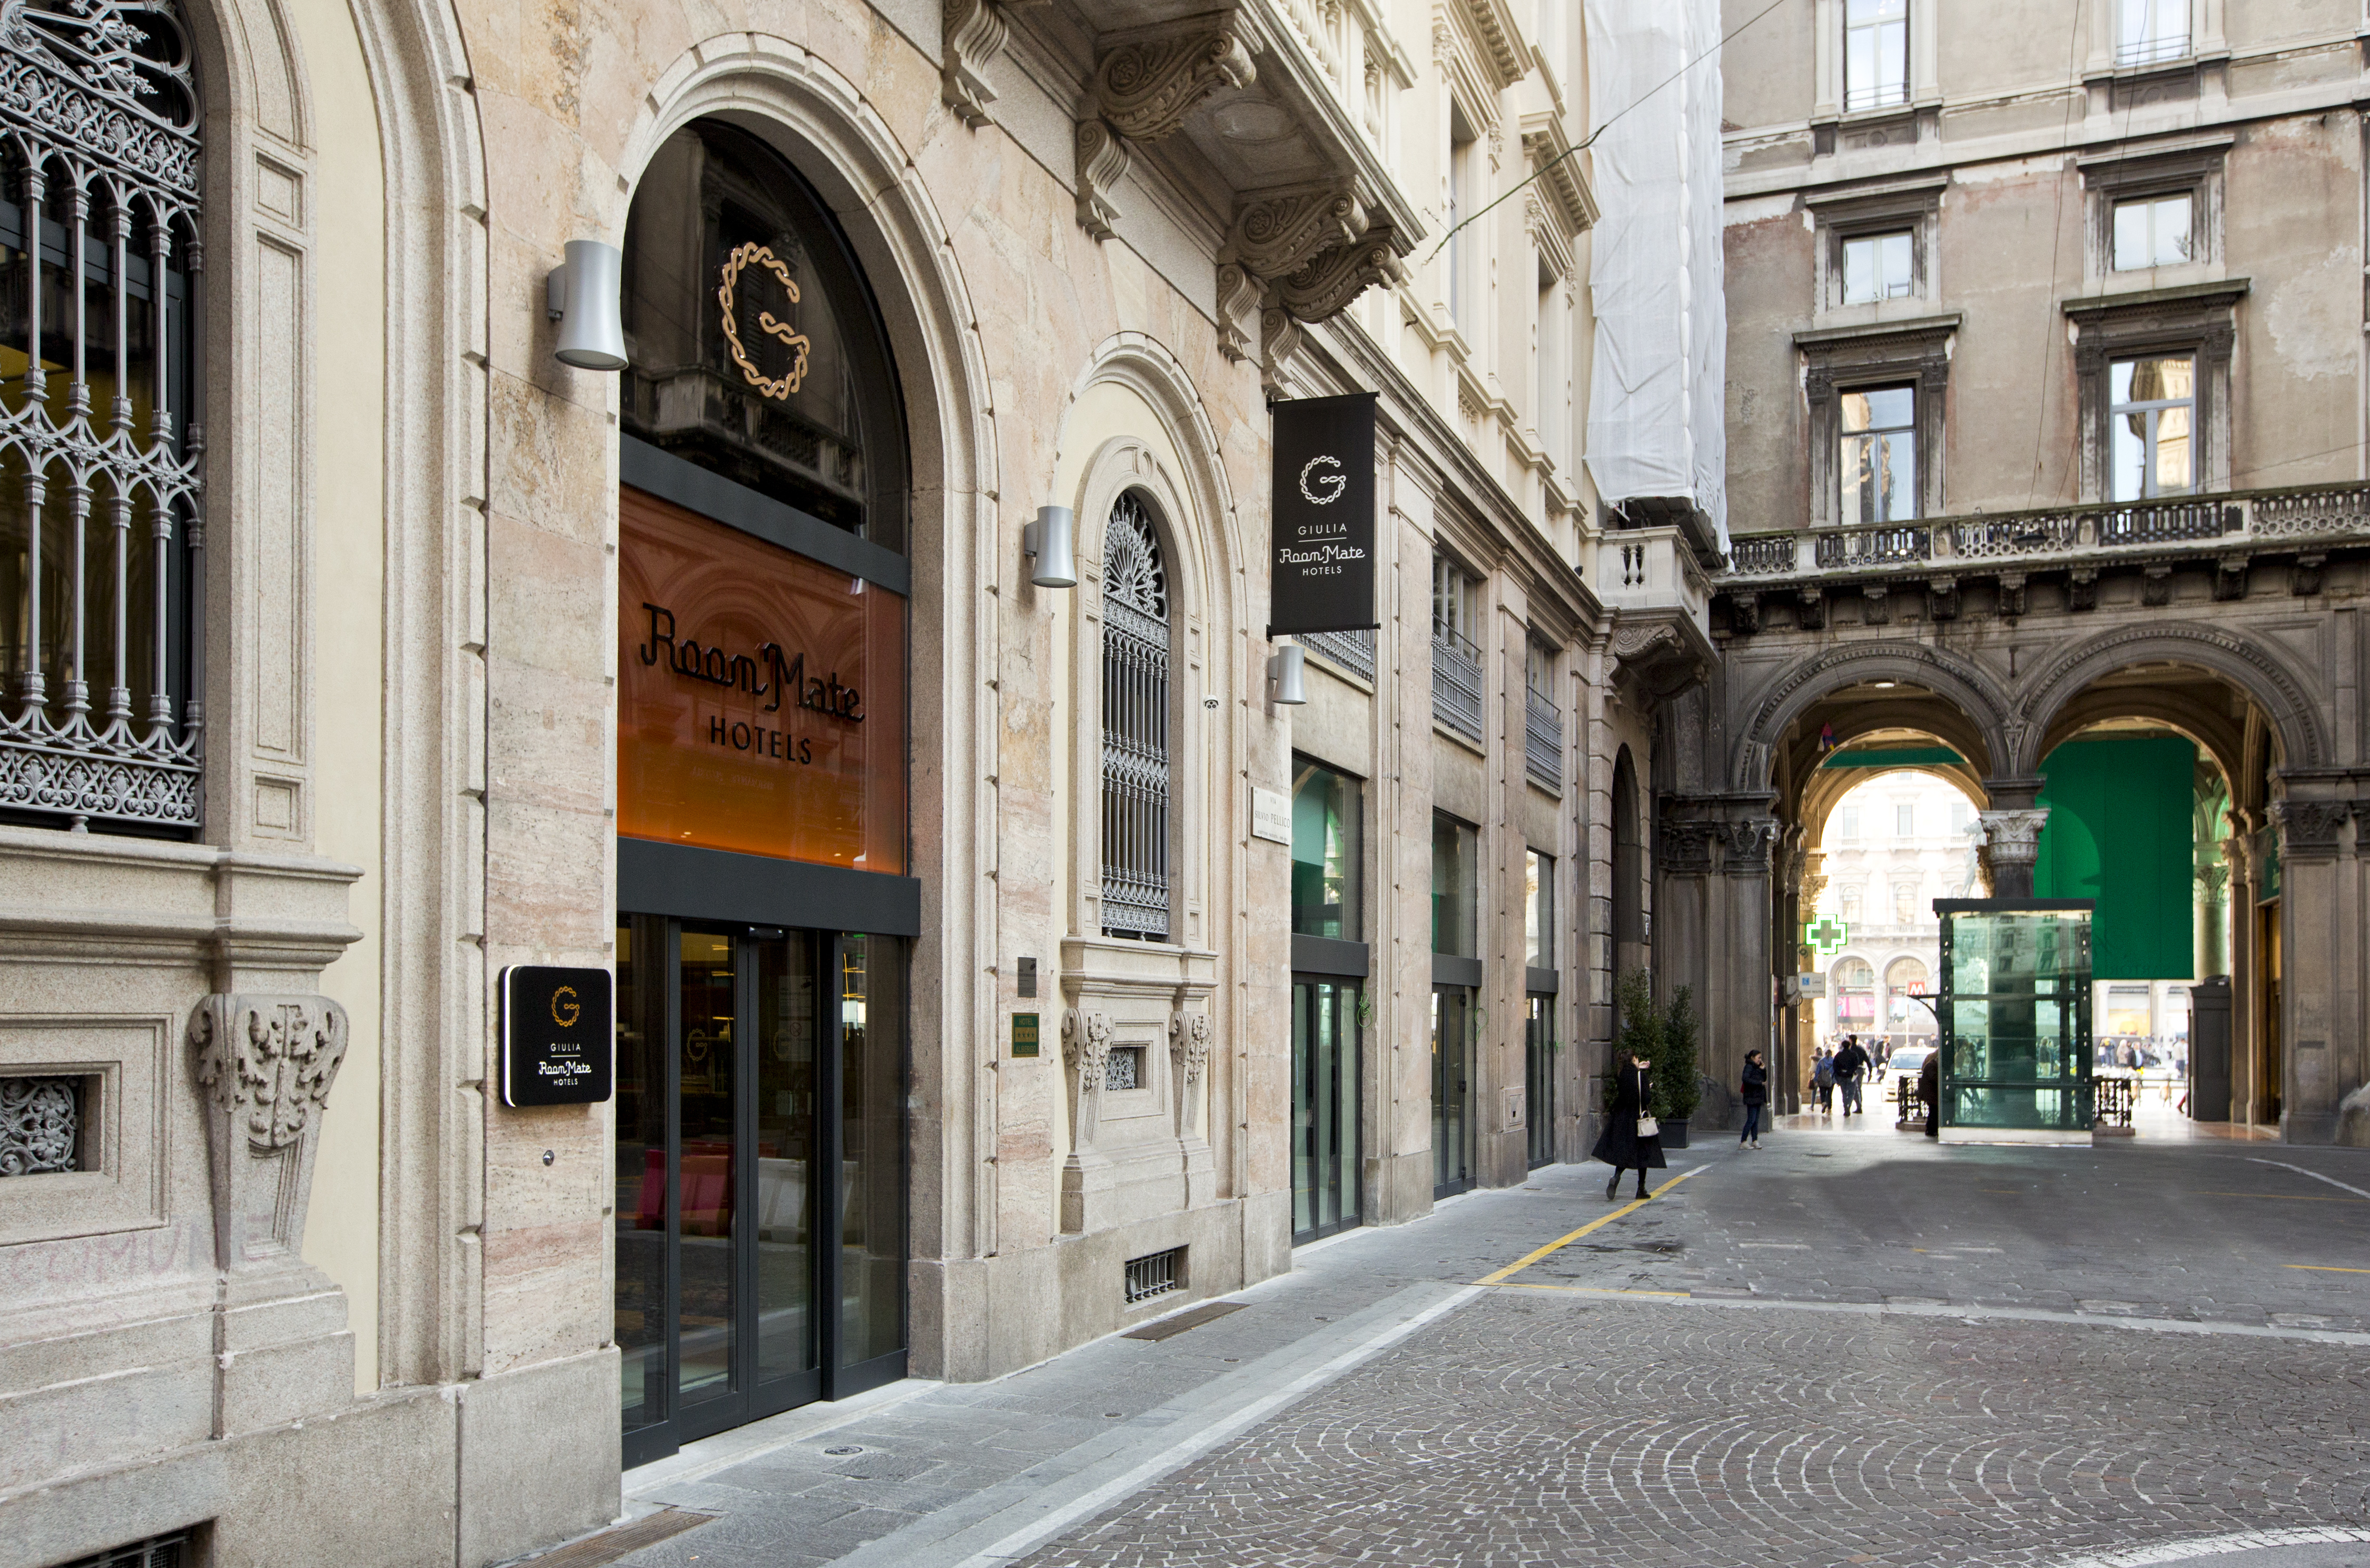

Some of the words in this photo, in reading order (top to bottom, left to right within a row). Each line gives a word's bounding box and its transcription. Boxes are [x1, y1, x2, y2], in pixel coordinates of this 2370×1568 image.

[1298, 523, 1347, 536] GIULIA
[1302, 565, 1342, 576] HOTELS
[710, 715, 812, 765] HOTELS
[1255, 810, 1269, 821] SILVIO
[1271, 813, 1290, 828] PELLICO
[550, 1043, 581, 1051] GIULIA
